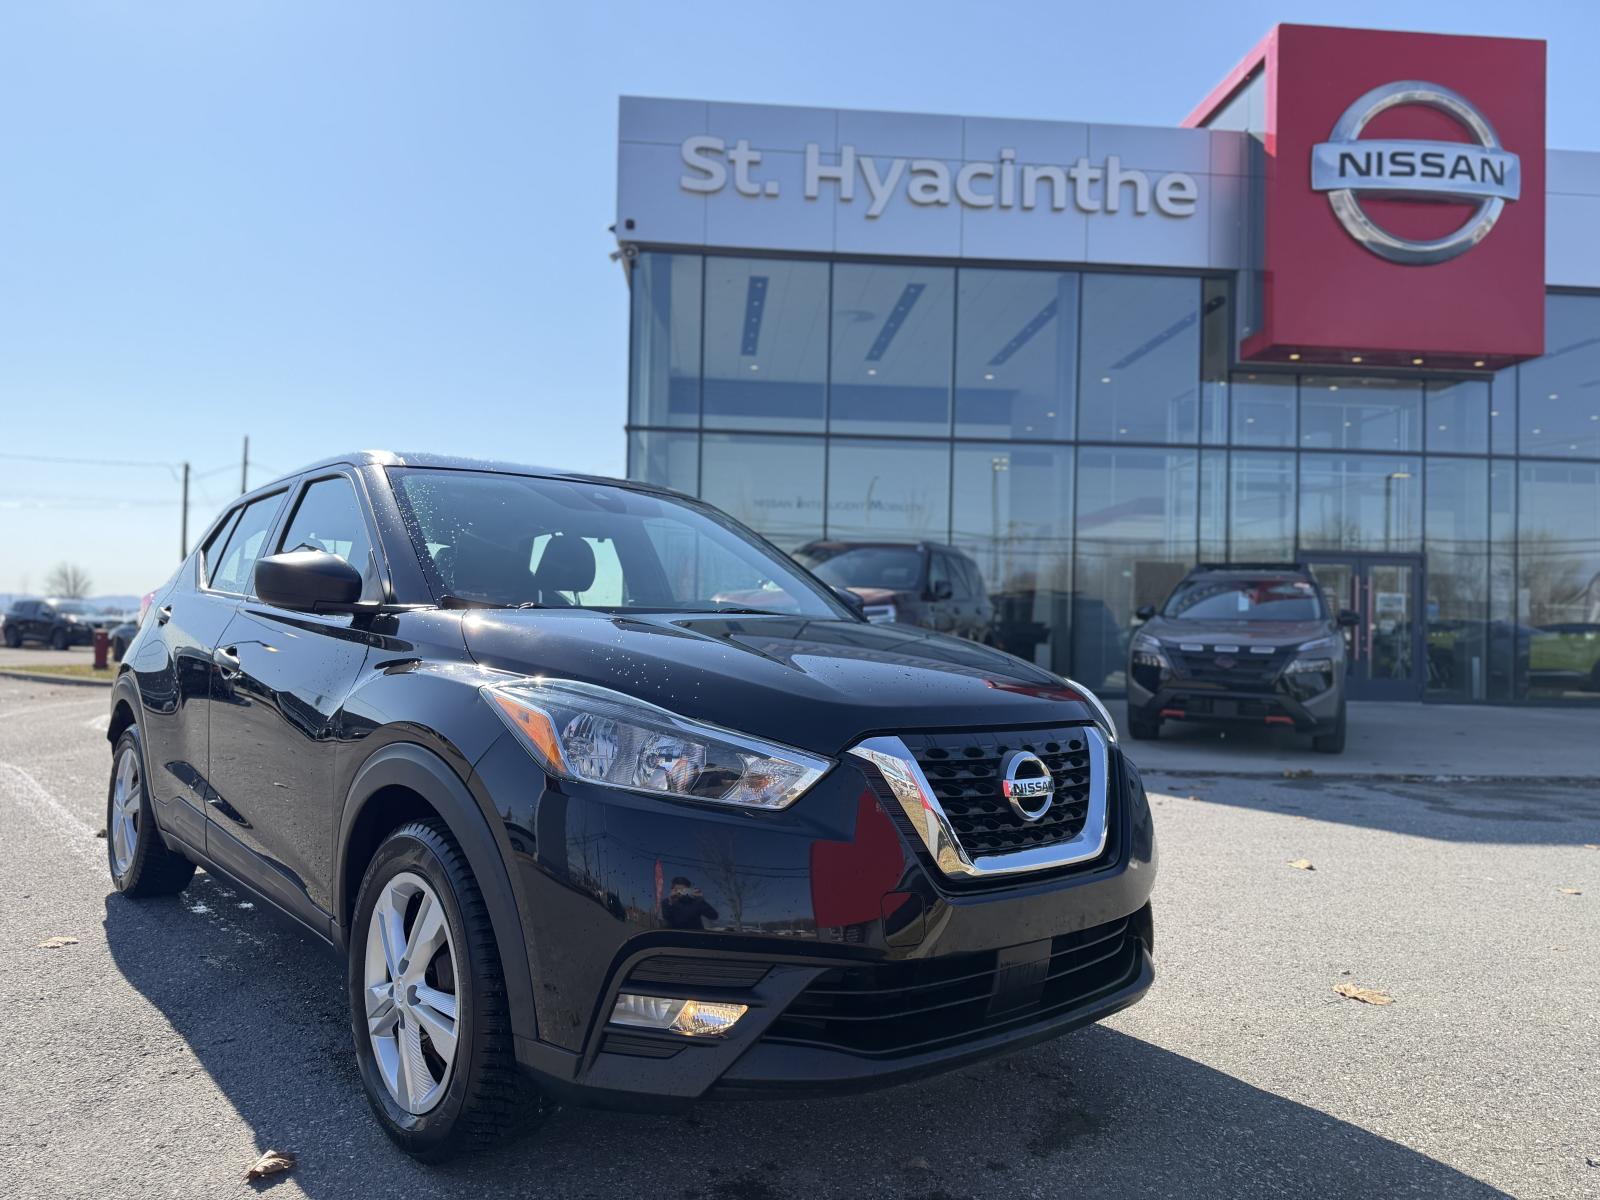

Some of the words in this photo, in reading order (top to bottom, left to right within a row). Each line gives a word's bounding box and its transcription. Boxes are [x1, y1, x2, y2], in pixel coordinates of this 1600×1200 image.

[681, 135, 779, 197] St.
[804, 142, 1199, 218] Hyacinthe
[1338, 151, 1505, 186] NISSAN
[1013, 781, 1054, 796] NISSAN
